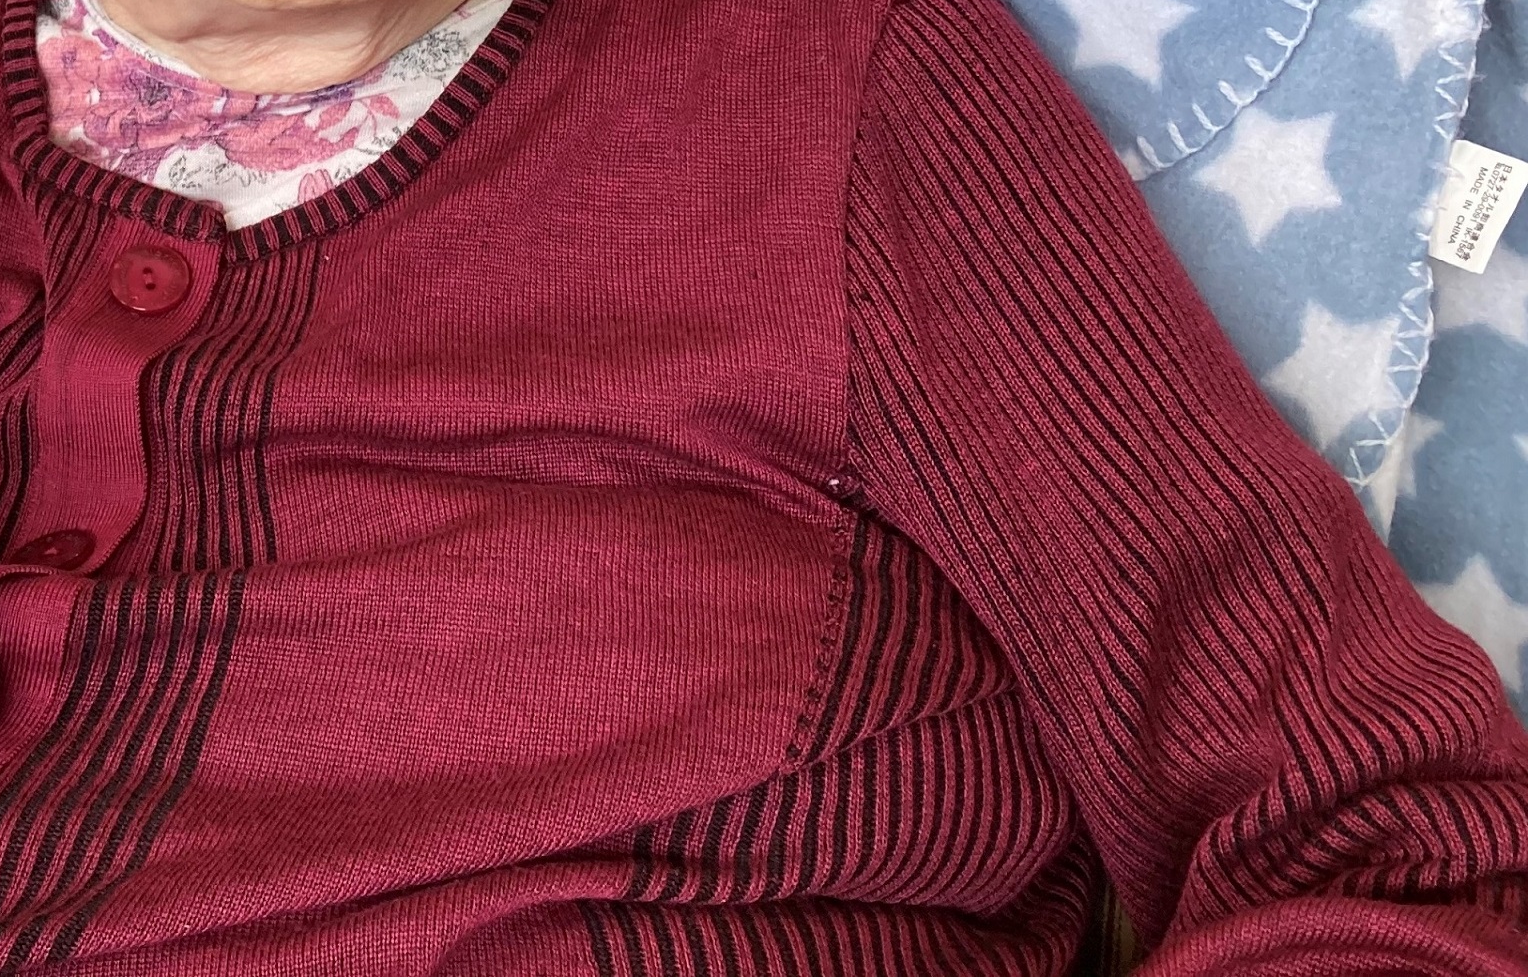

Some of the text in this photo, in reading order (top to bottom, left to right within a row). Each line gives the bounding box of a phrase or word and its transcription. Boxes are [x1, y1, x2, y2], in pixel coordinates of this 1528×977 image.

[1448, 167, 1489, 244] MADE IN CHINA
